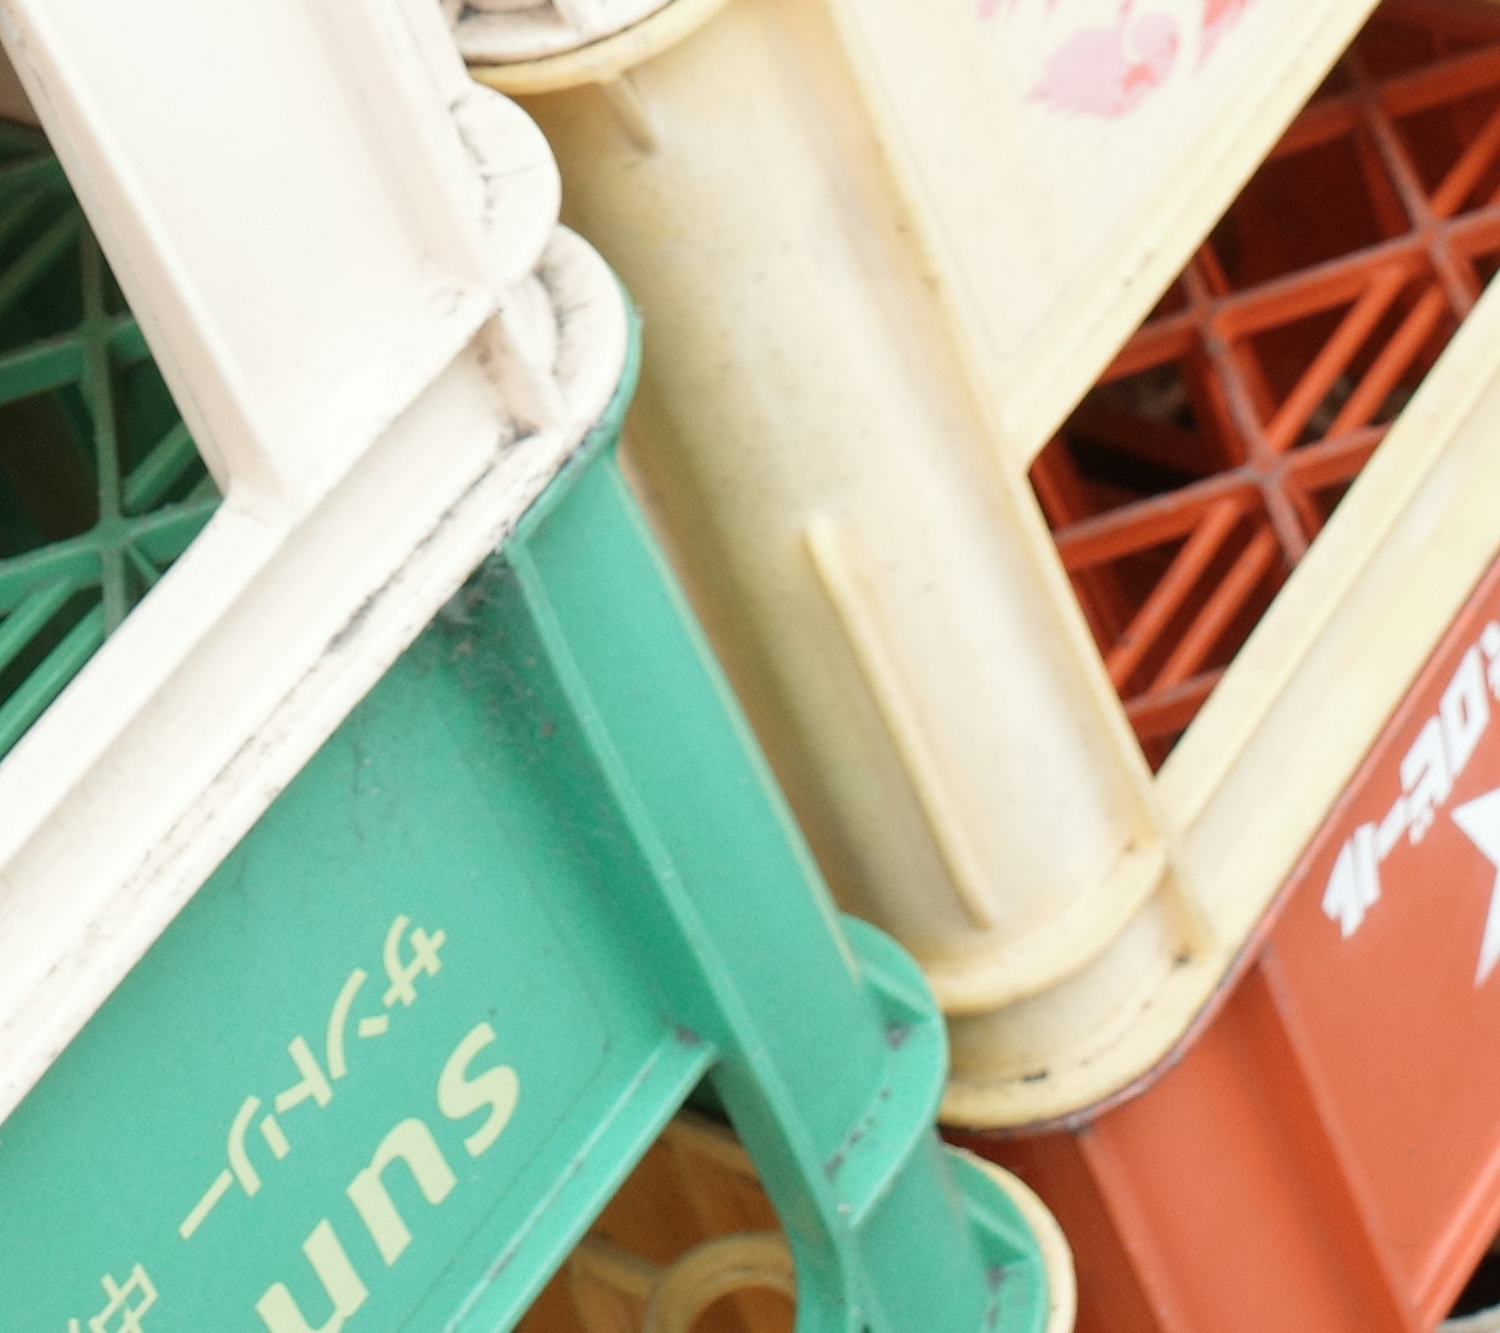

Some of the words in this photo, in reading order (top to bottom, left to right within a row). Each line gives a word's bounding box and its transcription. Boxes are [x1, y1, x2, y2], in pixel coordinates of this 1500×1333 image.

[179, 913, 447, 1241] サントリー
